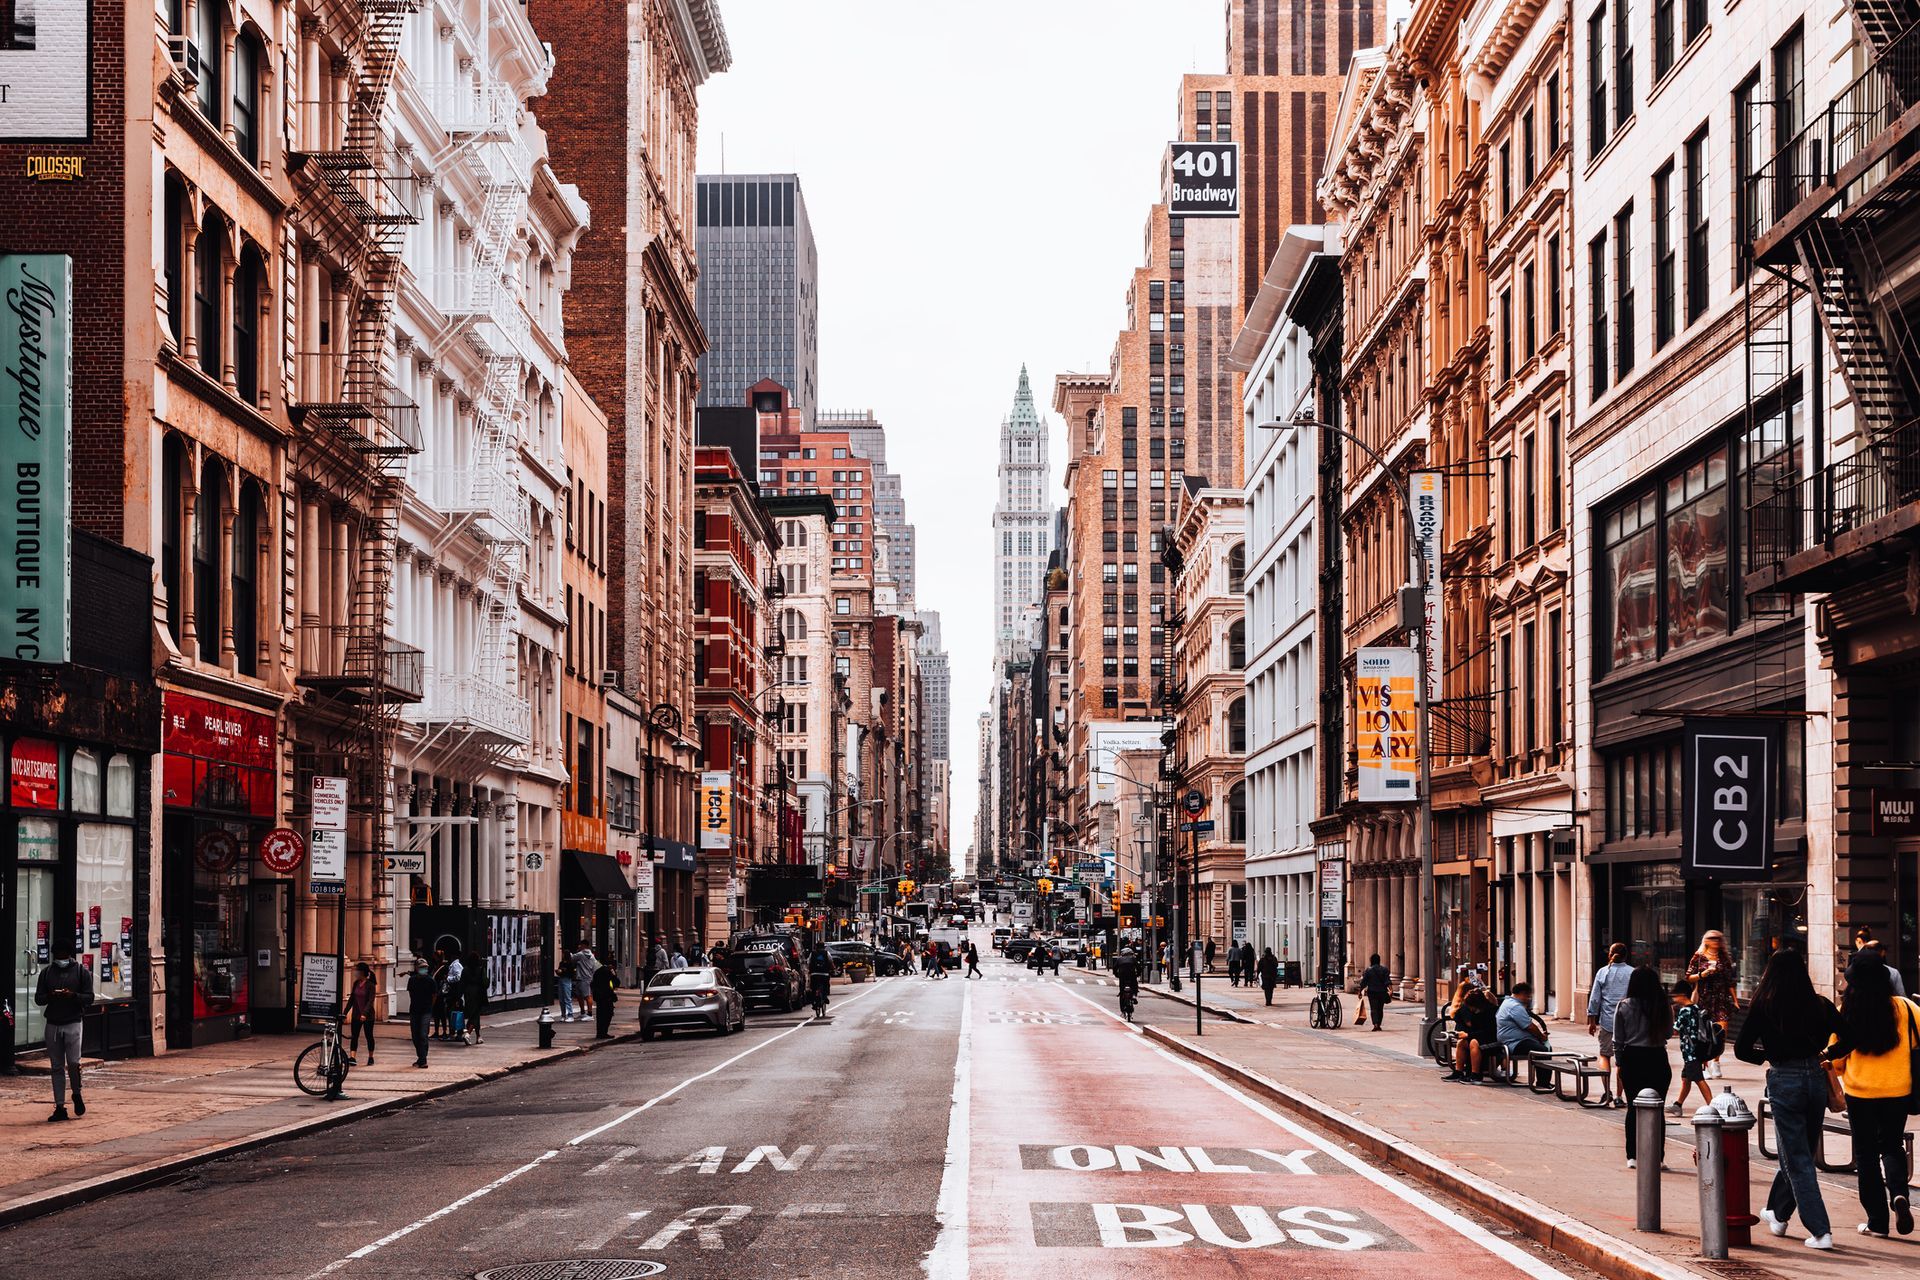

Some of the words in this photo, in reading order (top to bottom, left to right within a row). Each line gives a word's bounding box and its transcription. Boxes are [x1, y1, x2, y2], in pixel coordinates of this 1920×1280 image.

[1172, 150, 1232, 177] 401
[1172, 182, 1236, 207] Broadway
[6, 262, 56, 442] Mystique
[16, 462, 41, 589] BOUTIQUE
[15, 608, 40, 660] NYC
[204, 716, 224, 733] PEARL
[225, 721, 242, 737] RIVER
[316, 779, 322, 788] 3
[708, 790, 728, 828] tech
[1712, 755, 1749, 851] CB2
[1880, 801, 1914, 815] MUJI
[315, 831, 321, 841] 2
[398, 858, 422, 870] Valley
[310, 957, 333, 965] better
[1052, 1144, 1318, 1175] ONLY
[1093, 1202, 1379, 1251] BUS
